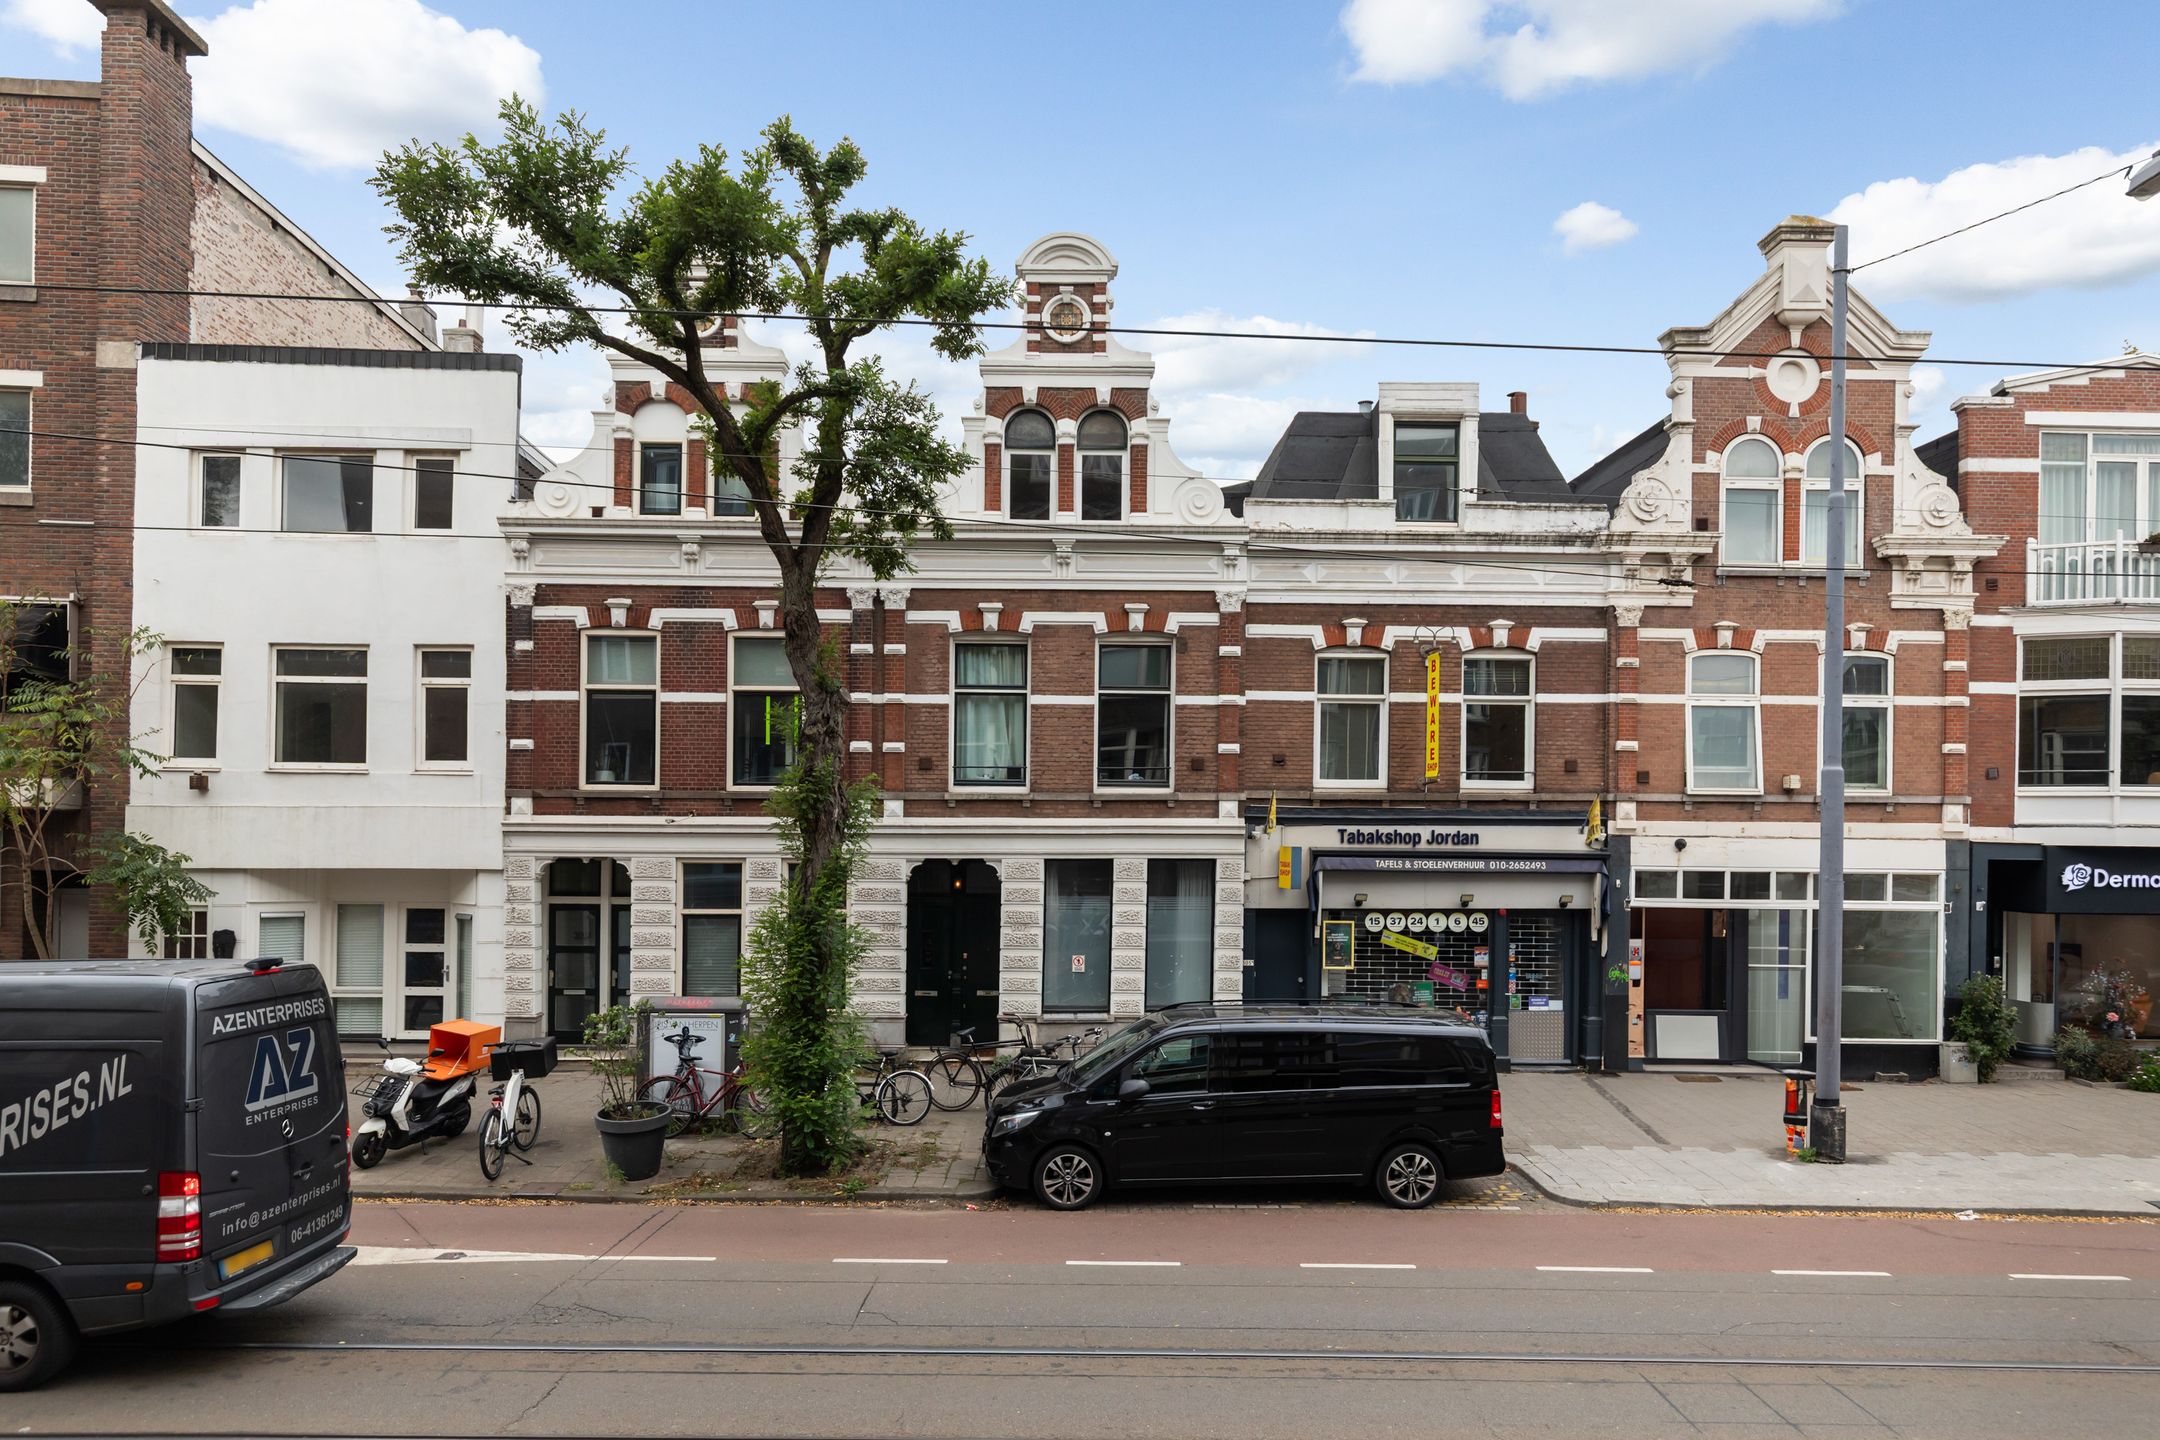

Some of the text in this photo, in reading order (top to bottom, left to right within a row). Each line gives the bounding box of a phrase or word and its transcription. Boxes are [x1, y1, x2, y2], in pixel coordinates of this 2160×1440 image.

[1429, 660, 1437, 760] BEWARE
[1338, 829, 1479, 848] Tabakshop Jordan
[1375, 860, 1547, 870] TAFELS & STOELENVERHUUR 010-2652493
[1369, 917, 1380, 926] 15
[1389, 917, 1402, 926] 37
[1410, 917, 1423, 926] 24
[1472, 917, 1485, 926] 45
[212, 997, 326, 1035] AZENTERPRISES
[244, 1026, 319, 1112] AZ
[245, 1095, 319, 1126] ENTERPRISES
[222, 1174, 341, 1237] info@azenterprises.nl
[291, 1205, 343, 1244] 06-41361249
